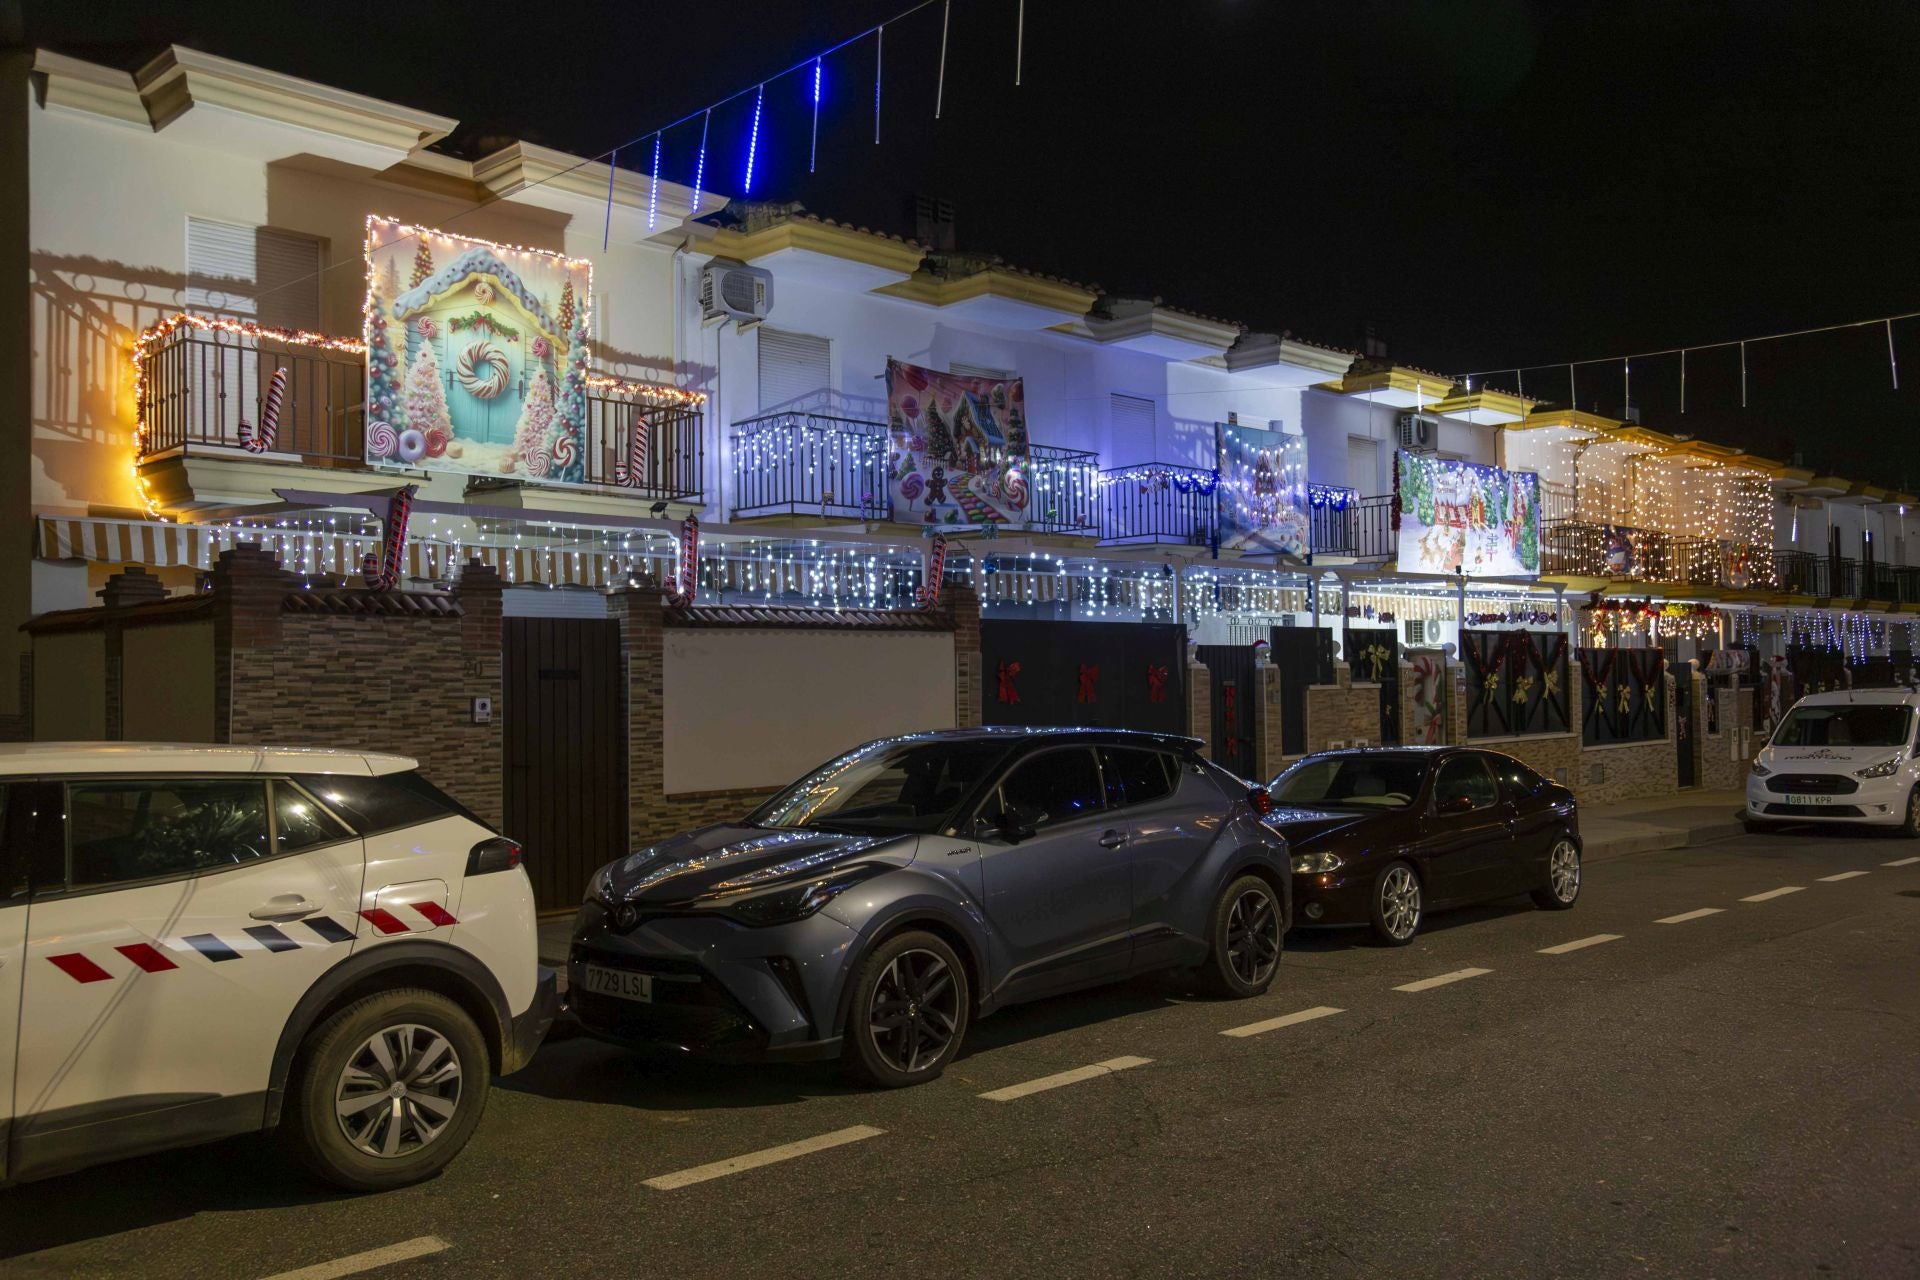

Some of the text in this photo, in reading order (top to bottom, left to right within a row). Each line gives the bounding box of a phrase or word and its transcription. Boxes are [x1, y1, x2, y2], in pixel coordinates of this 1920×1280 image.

[1815, 796, 1832, 804] KPR
[588, 968, 648, 998] 7729 LSL
